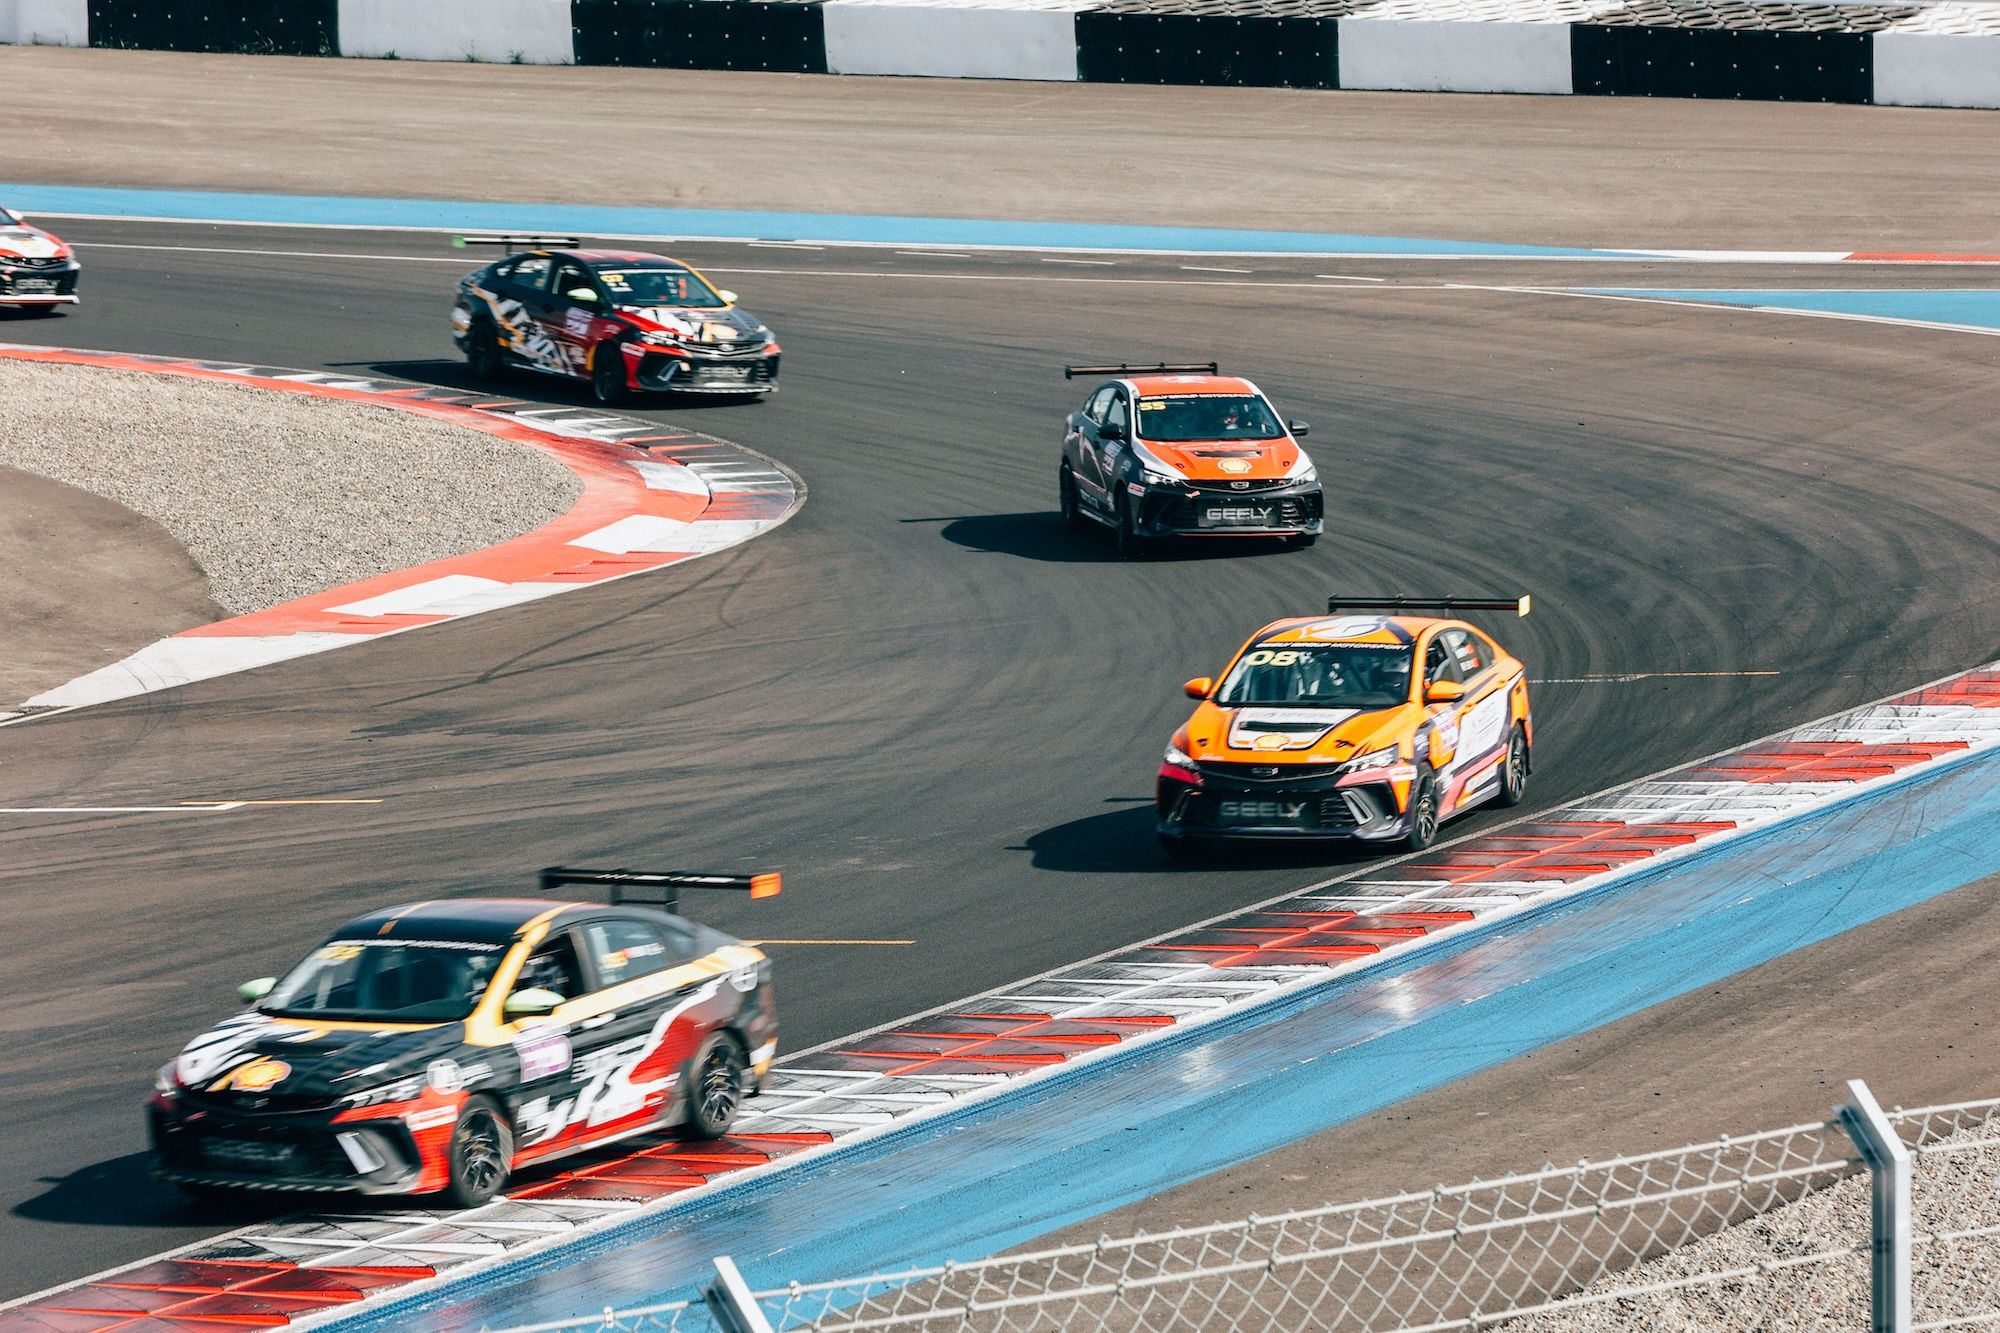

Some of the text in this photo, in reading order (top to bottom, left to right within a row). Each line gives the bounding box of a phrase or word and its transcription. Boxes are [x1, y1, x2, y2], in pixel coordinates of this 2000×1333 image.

[1139, 401, 1167, 411] 55
[1206, 506, 1273, 521] GEELY
[1331, 642, 1410, 651] MOTORSPORT
[1245, 650, 1300, 667] 08
[1220, 801, 1308, 818] GEELY
